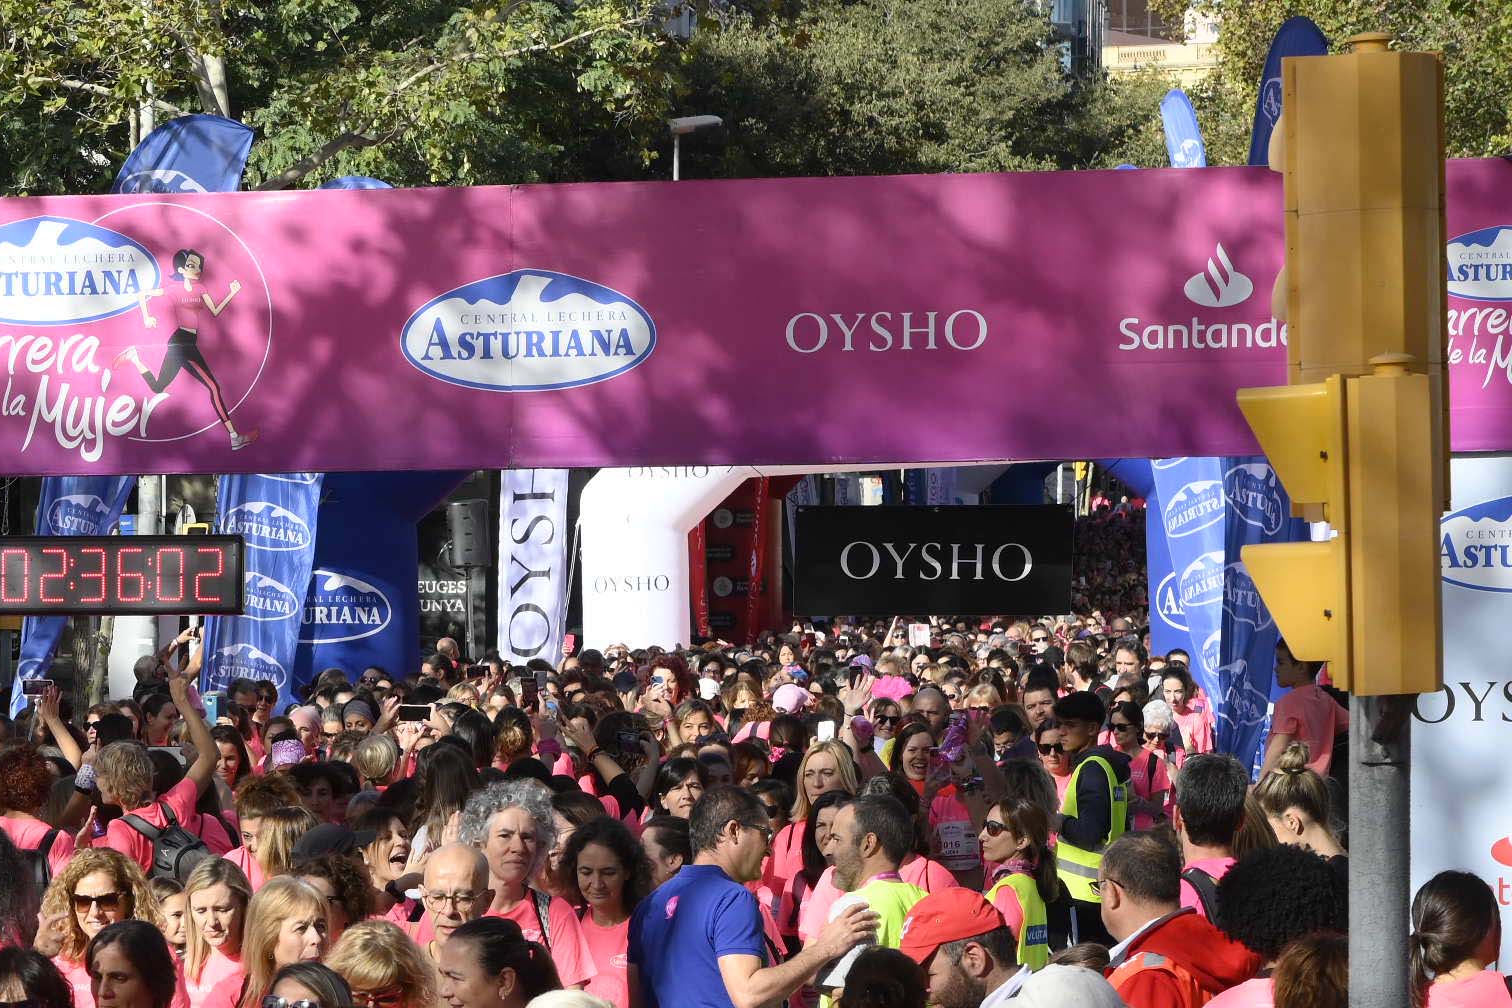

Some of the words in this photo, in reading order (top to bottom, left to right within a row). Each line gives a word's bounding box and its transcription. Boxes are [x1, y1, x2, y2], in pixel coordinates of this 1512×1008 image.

[64, 252, 137, 265] LECHERA
[460, 311, 537, 326] CENTRAL
[544, 310, 628, 323] LECHERA
[785, 309, 988, 353] OYSHO
[420, 316, 636, 361] ASTURIANA
[1469, 336, 1486, 364] la
[1, 378, 26, 417] la
[21, 369, 170, 462] Mujer
[228, 513, 304, 545] ASTURIANA
[0, 547, 223, 602] 02:36:02
[839, 540, 1034, 582] OYSHO
[594, 574, 670, 594] OYSHO
[218, 664, 279, 685] STURIANA
